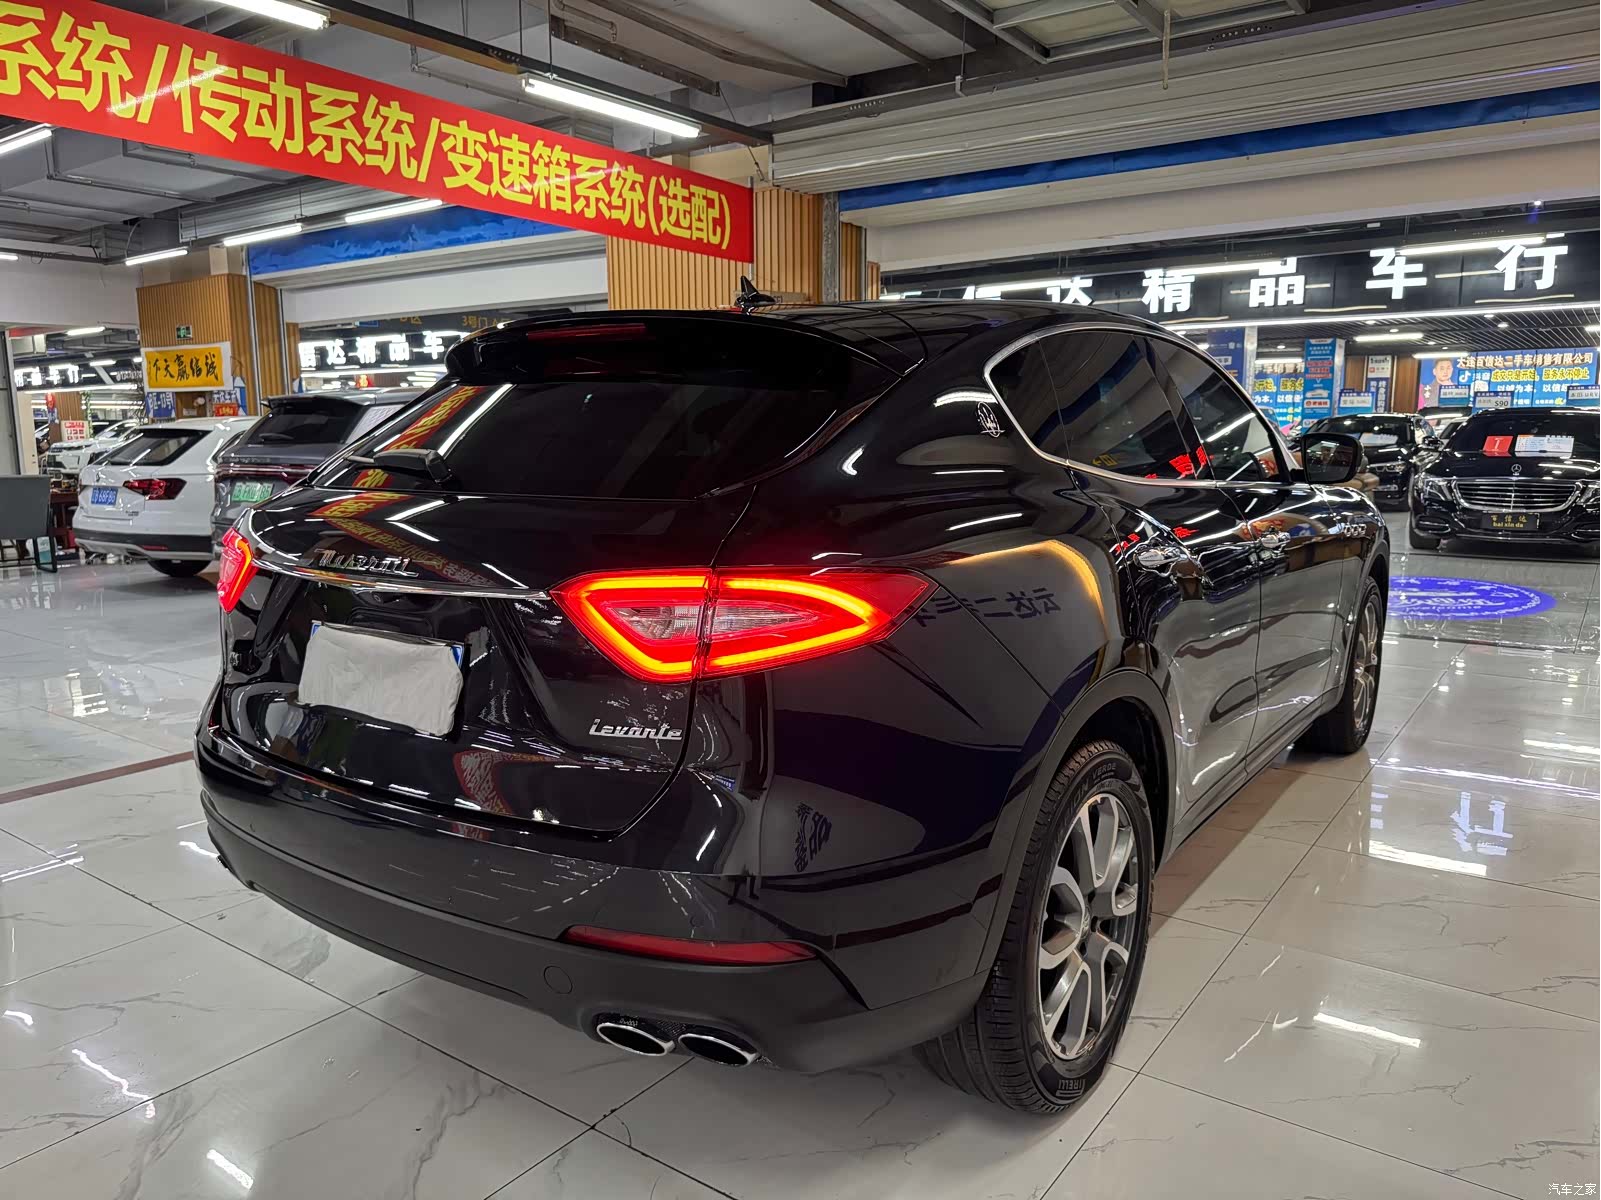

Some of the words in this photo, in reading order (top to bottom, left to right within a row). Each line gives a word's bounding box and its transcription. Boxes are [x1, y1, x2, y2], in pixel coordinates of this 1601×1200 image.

[314, 549, 419, 577] Maserati
[589, 719, 683, 740] Levante
[1092, 763, 1116, 778] VERDE
